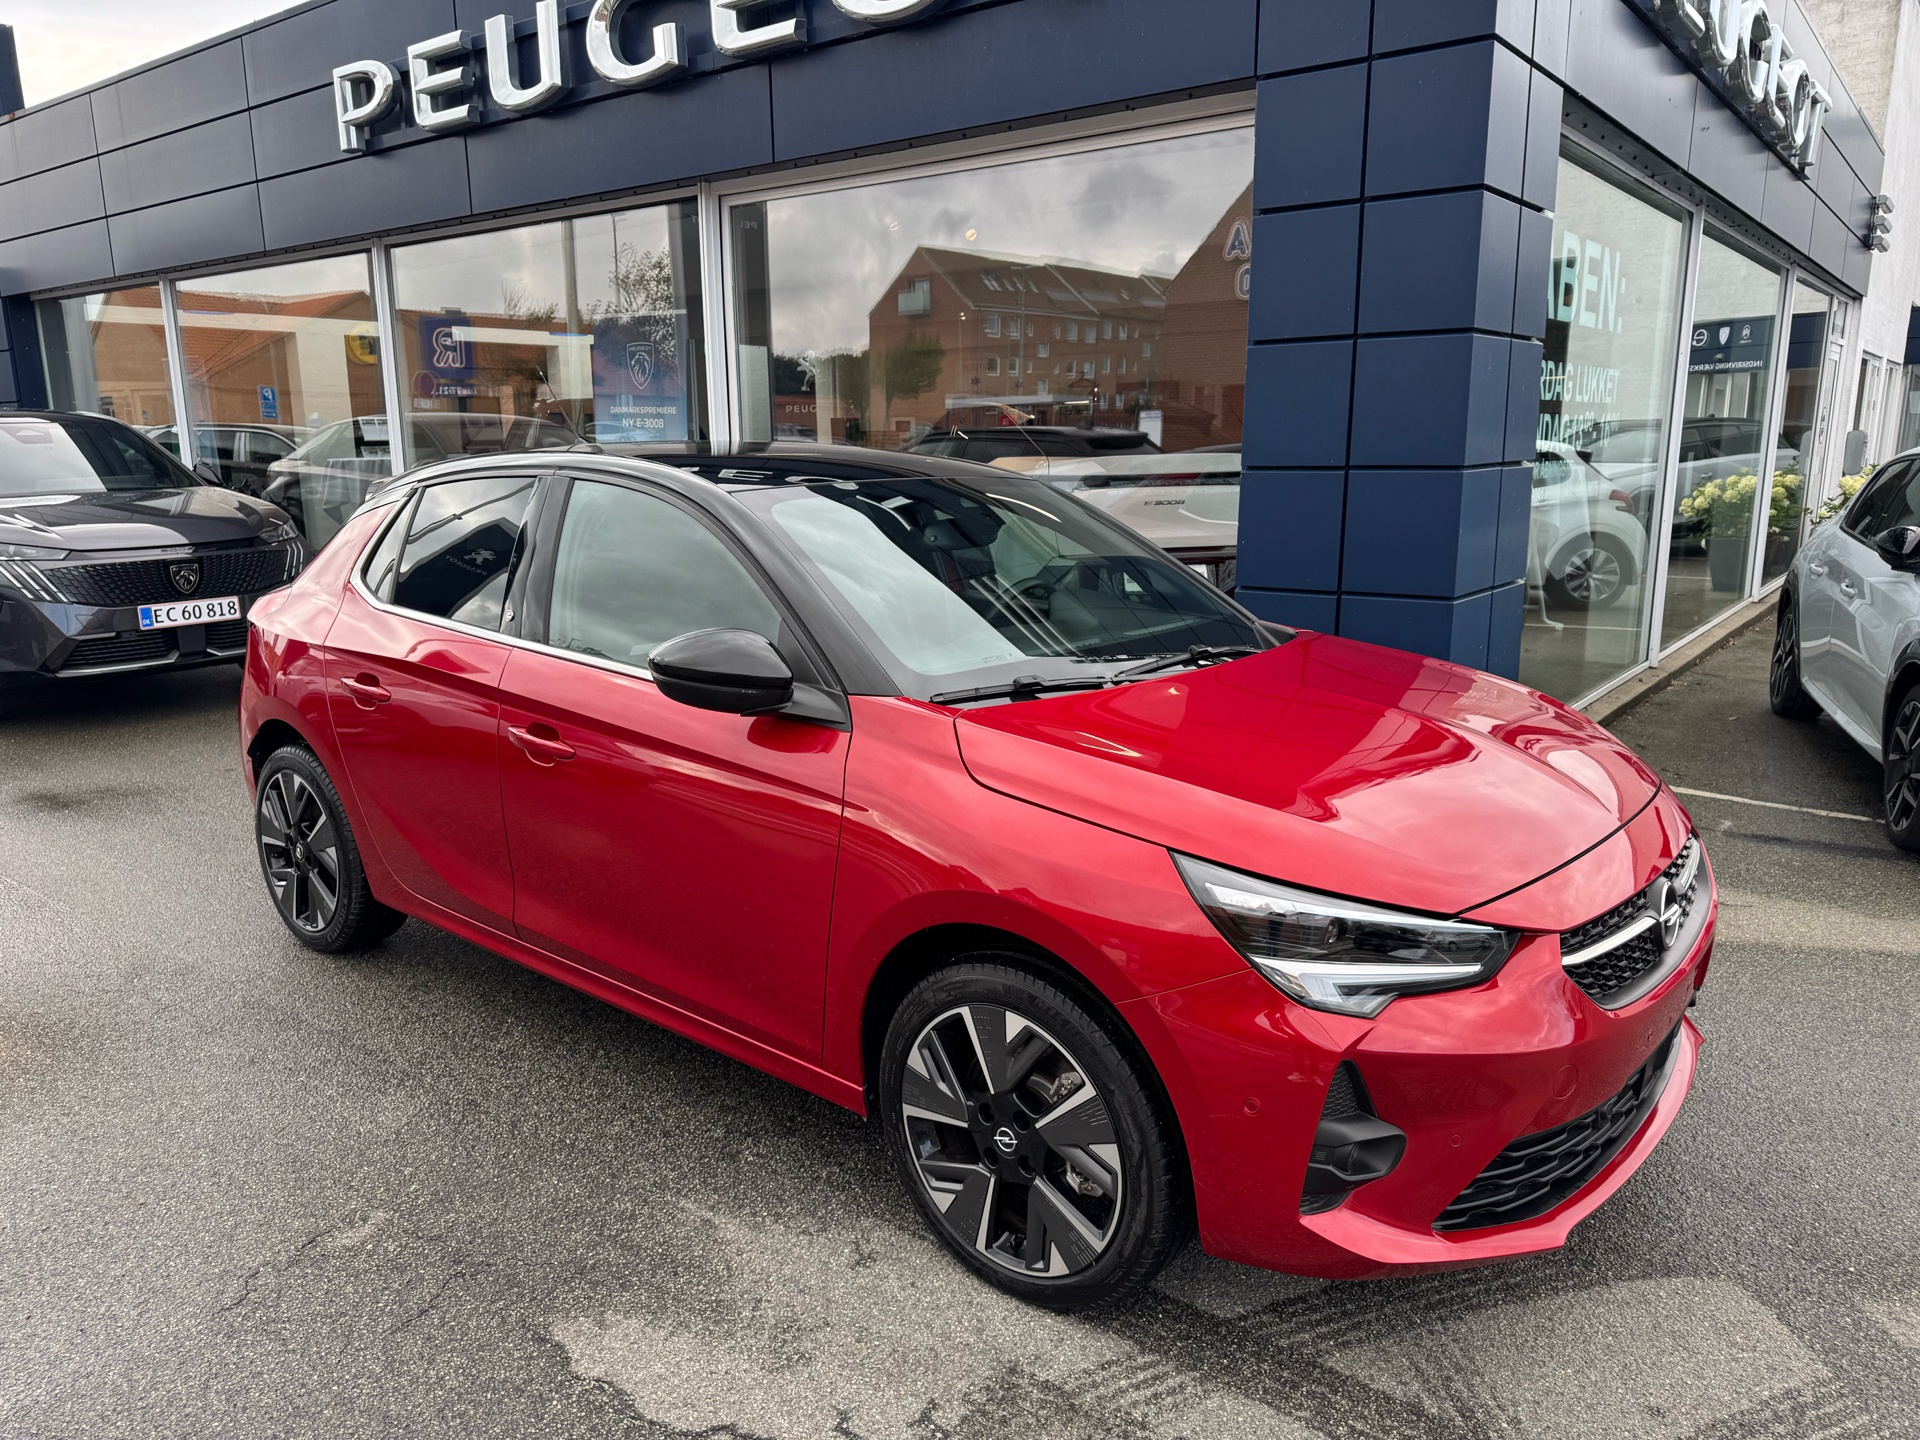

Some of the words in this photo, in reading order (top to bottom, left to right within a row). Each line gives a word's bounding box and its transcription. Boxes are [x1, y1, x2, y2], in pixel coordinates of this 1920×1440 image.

[332, 0, 945, 154] PEUGE
[1654, 0, 1832, 167] UGEOT
[1575, 364, 1620, 404] LUKKET
[610, 406, 677, 414] DANMARKSPREMIERE
[622, 418, 635, 428] NY
[636, 418, 664, 428] E-3008
[153, 606, 178, 624] EC
[181, 604, 202, 621] 60
[206, 600, 237, 618] 818
